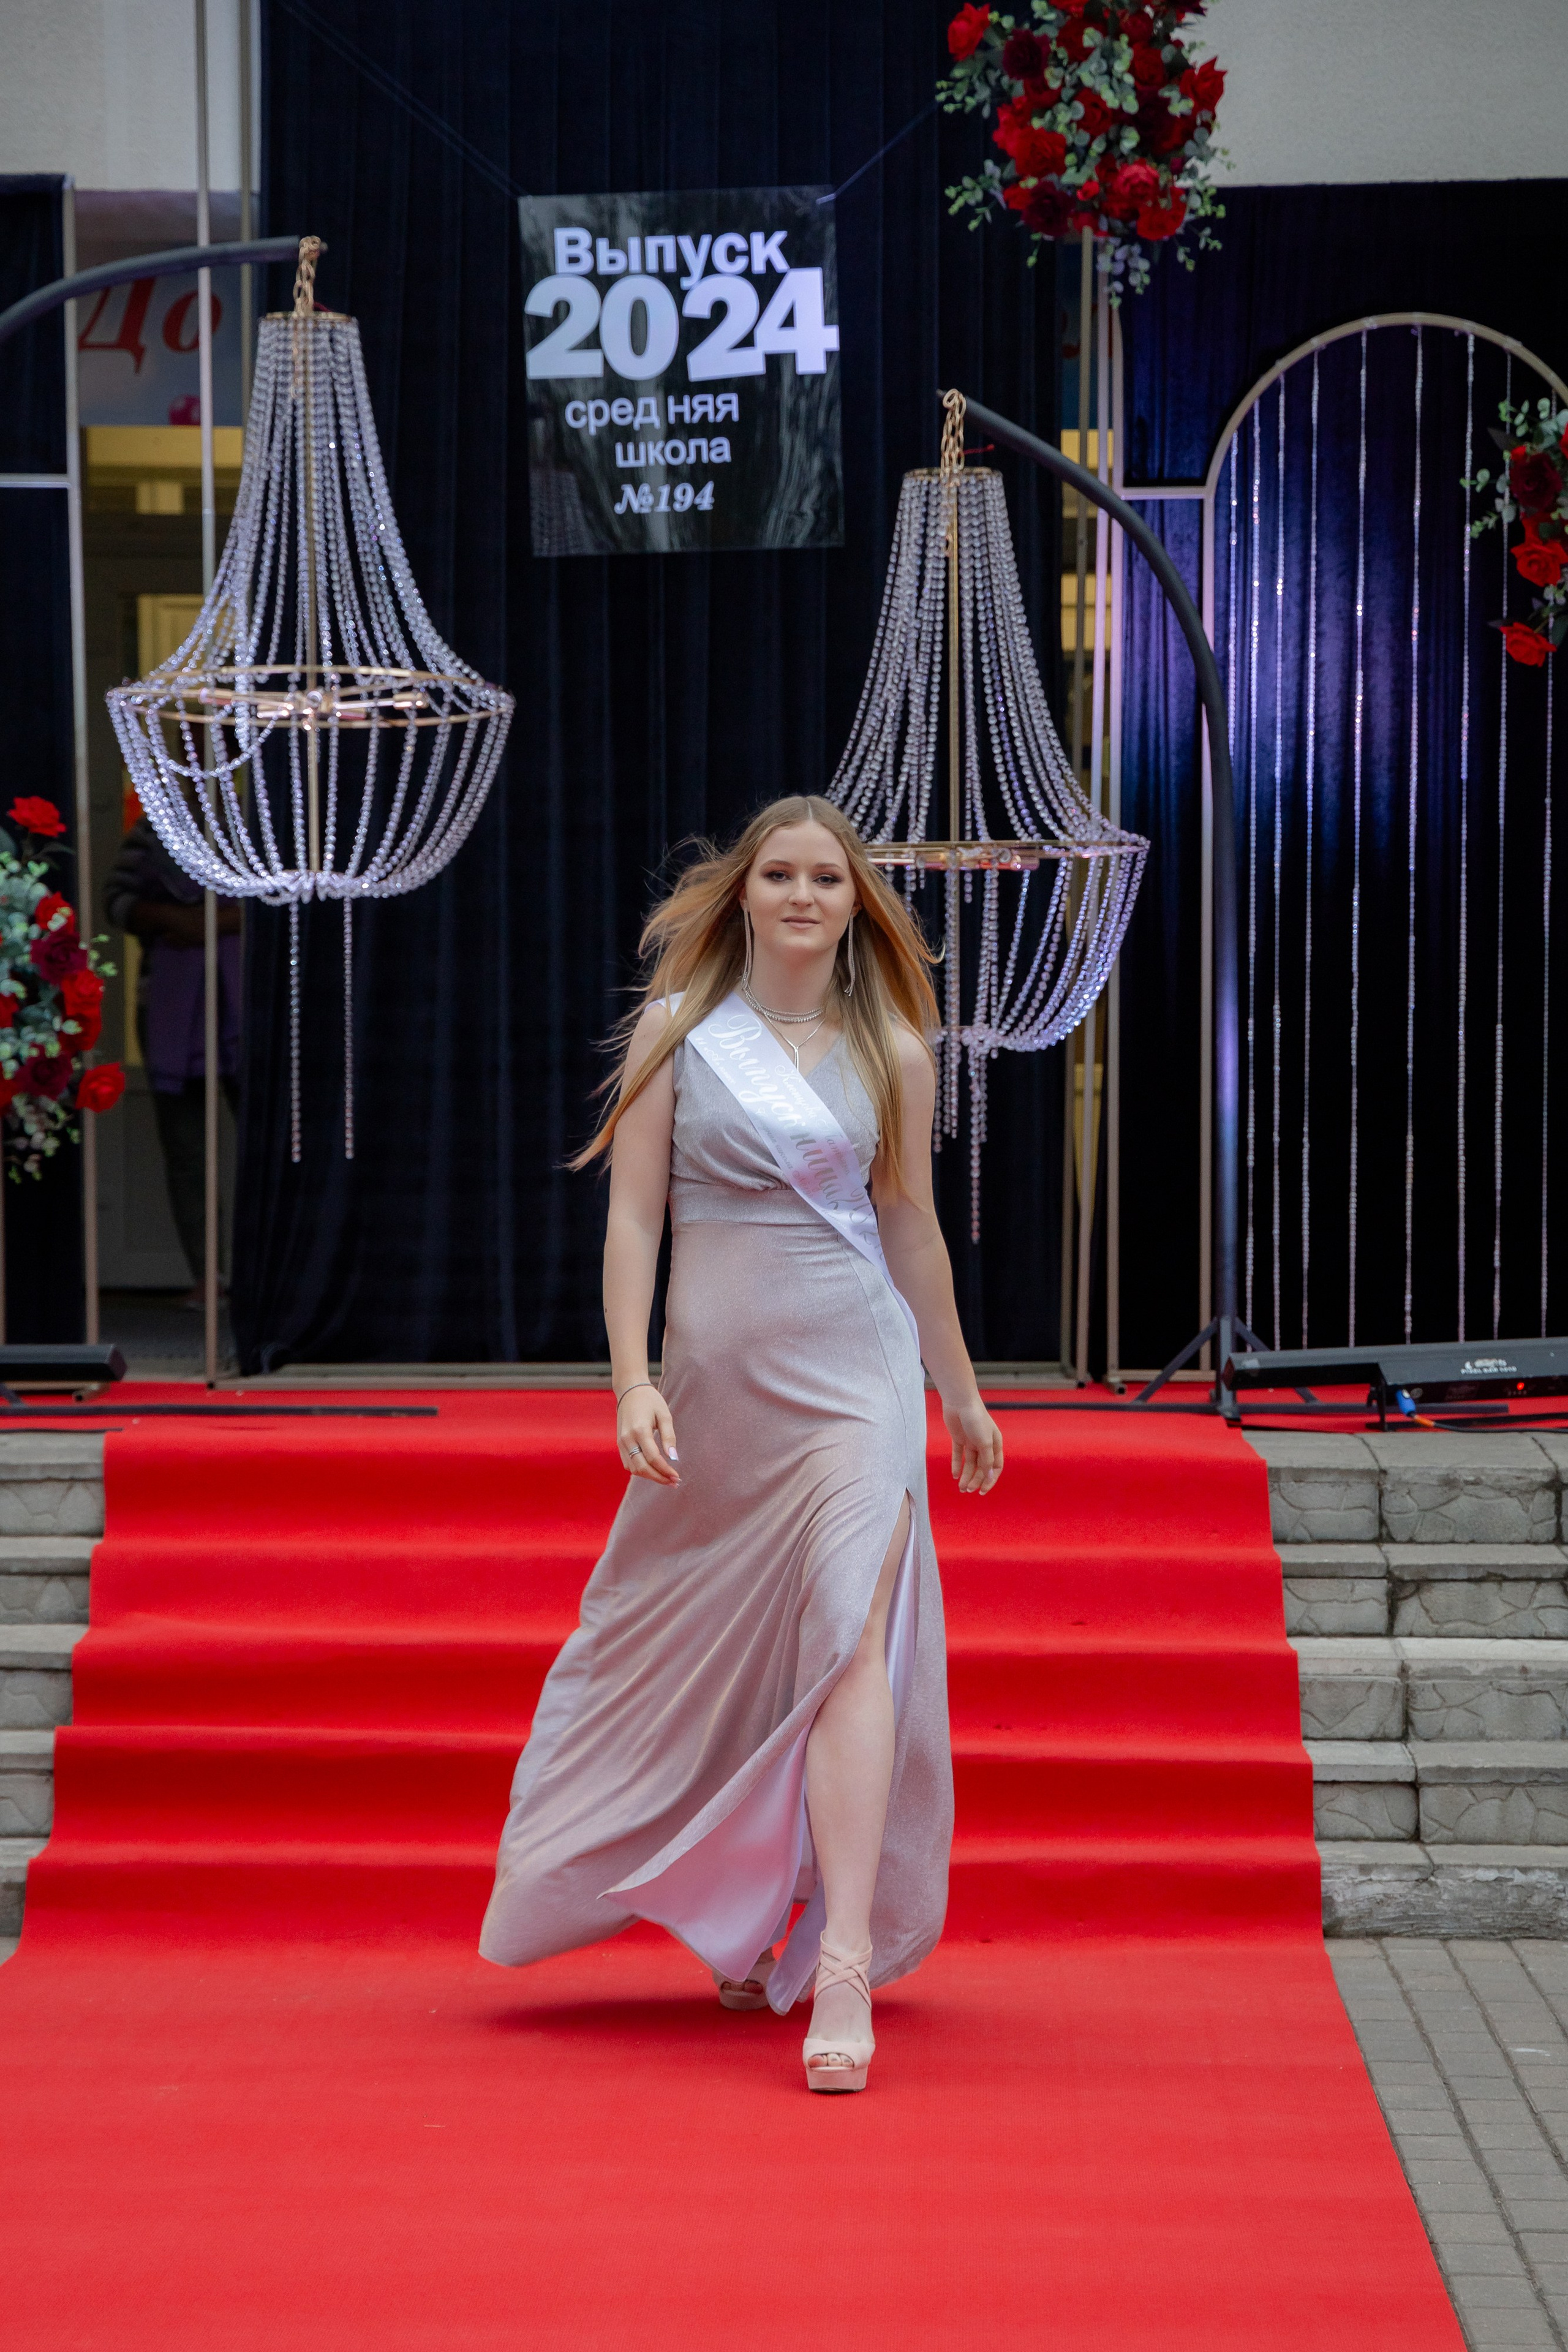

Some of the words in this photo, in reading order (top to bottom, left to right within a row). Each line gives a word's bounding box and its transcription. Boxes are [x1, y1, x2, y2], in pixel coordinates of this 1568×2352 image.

[554, 227, 789, 290] Выпуск
[524, 267, 840, 382] 2024
[615, 437, 731, 467] школа
[614, 481, 715, 514] №194
[708, 1014, 842, 1200] Выпускница
